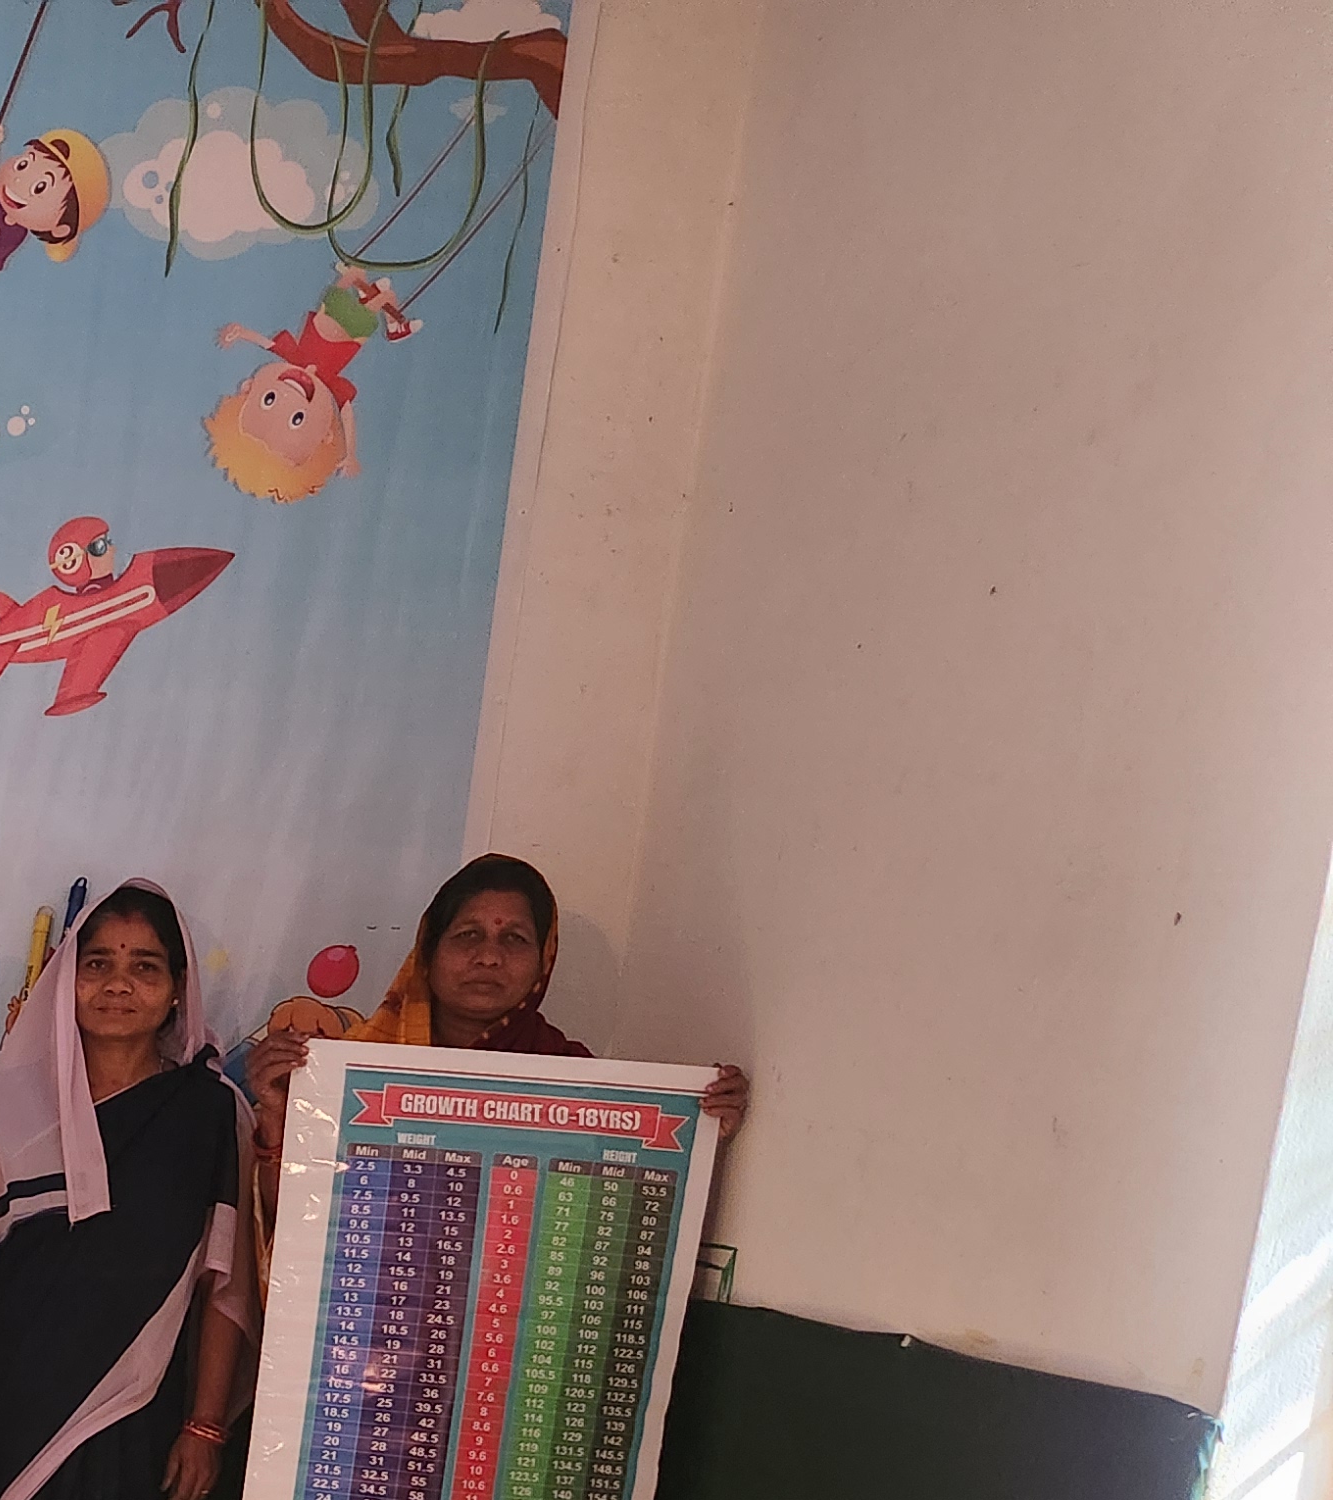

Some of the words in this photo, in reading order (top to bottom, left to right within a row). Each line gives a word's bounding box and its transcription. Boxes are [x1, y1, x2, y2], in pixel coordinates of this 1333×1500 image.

[400, 1093, 477, 1119] GROWTH
[483, 1097, 543, 1123] CHART
[548, 1101, 641, 1132] (0-18YRS)
[397, 1132, 436, 1146] WEIGHT
[355, 1145, 379, 1157] Min
[402, 1149, 426, 1160] Mid
[444, 1152, 471, 1164] Max
[502, 1155, 530, 1167] Age
[602, 1149, 637, 1163] HEIGHT
[356, 1161, 375, 1171] 2.5
[403, 1164, 422, 1174] 3.3
[446, 1168, 466, 1177] 4.5
[510, 1171, 518, 1180] 0
[558, 1161, 582, 1174] Min
[602, 1166, 625, 1178] Mid
[643, 1170, 669, 1183] Max
[604, 1181, 618, 1192] 50
[642, 1186, 667, 1197] 53.5
[350, 1219, 368, 1229] 9.6
[400, 1222, 415, 1232] 12
[444, 1226, 458, 1236] 15
[504, 1229, 512, 1239] 2
[594, 1241, 610, 1251] 87
[637, 1246, 651, 1255] 94
[340, 1277, 365, 1288] 12.5
[393, 1281, 408, 1291] 16
[436, 1285, 451, 1294] 21
[496, 1289, 504, 1298] 4
[539, 1295, 563, 1306] 95.5
[584, 1300, 604, 1310] 103
[627, 1305, 644, 1315] 111
[333, 1335, 358, 1345] 14.5
[386, 1340, 400, 1349] 19
[429, 1344, 444, 1354] 28
[488, 1348, 496, 1357] 6
[574, 1359, 593, 1369] 115
[615, 1363, 635, 1373] 126
[323, 1407, 349, 1418] 18.5
[375, 1413, 390, 1422] 26
[418, 1418, 435, 1428] 42
[472, 1421, 490, 1431] 8.6
[522, 1428, 541, 1438] 116
[563, 1432, 582, 1442] 129
[604, 1436, 623, 1446] 142
[315, 1464, 341, 1475] 21.5
[361, 1470, 388, 1481] 32.5
[411, 1476, 427, 1487] 55
[462, 1480, 485, 1490] 10.6
[553, 1490, 572, 1500] 140
